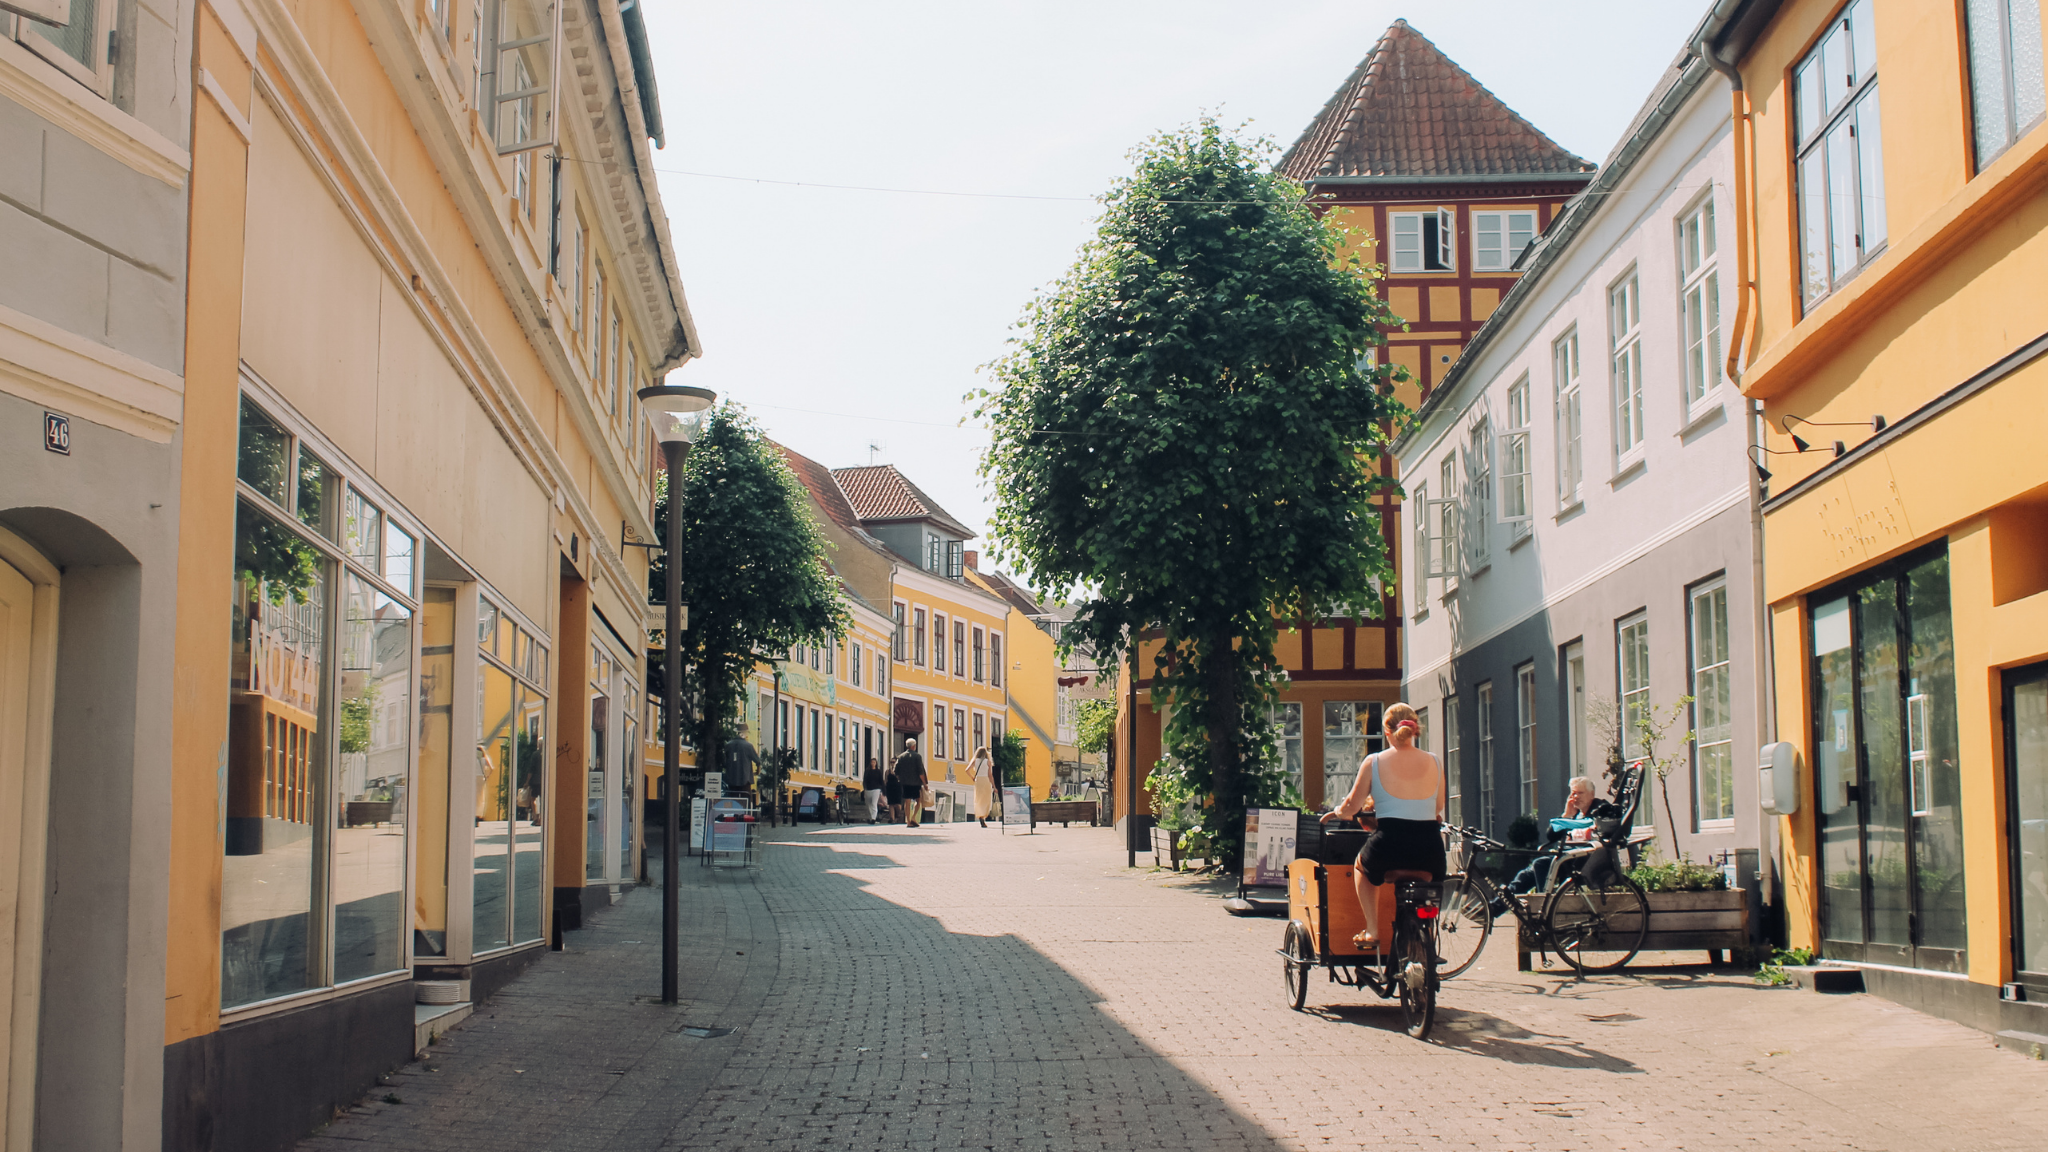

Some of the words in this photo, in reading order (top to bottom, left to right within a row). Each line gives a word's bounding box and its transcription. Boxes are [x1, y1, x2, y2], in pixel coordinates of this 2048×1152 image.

[50, 419, 69, 447] 46
[249, 618, 285, 700] NO
[290, 640, 317, 712] 44
